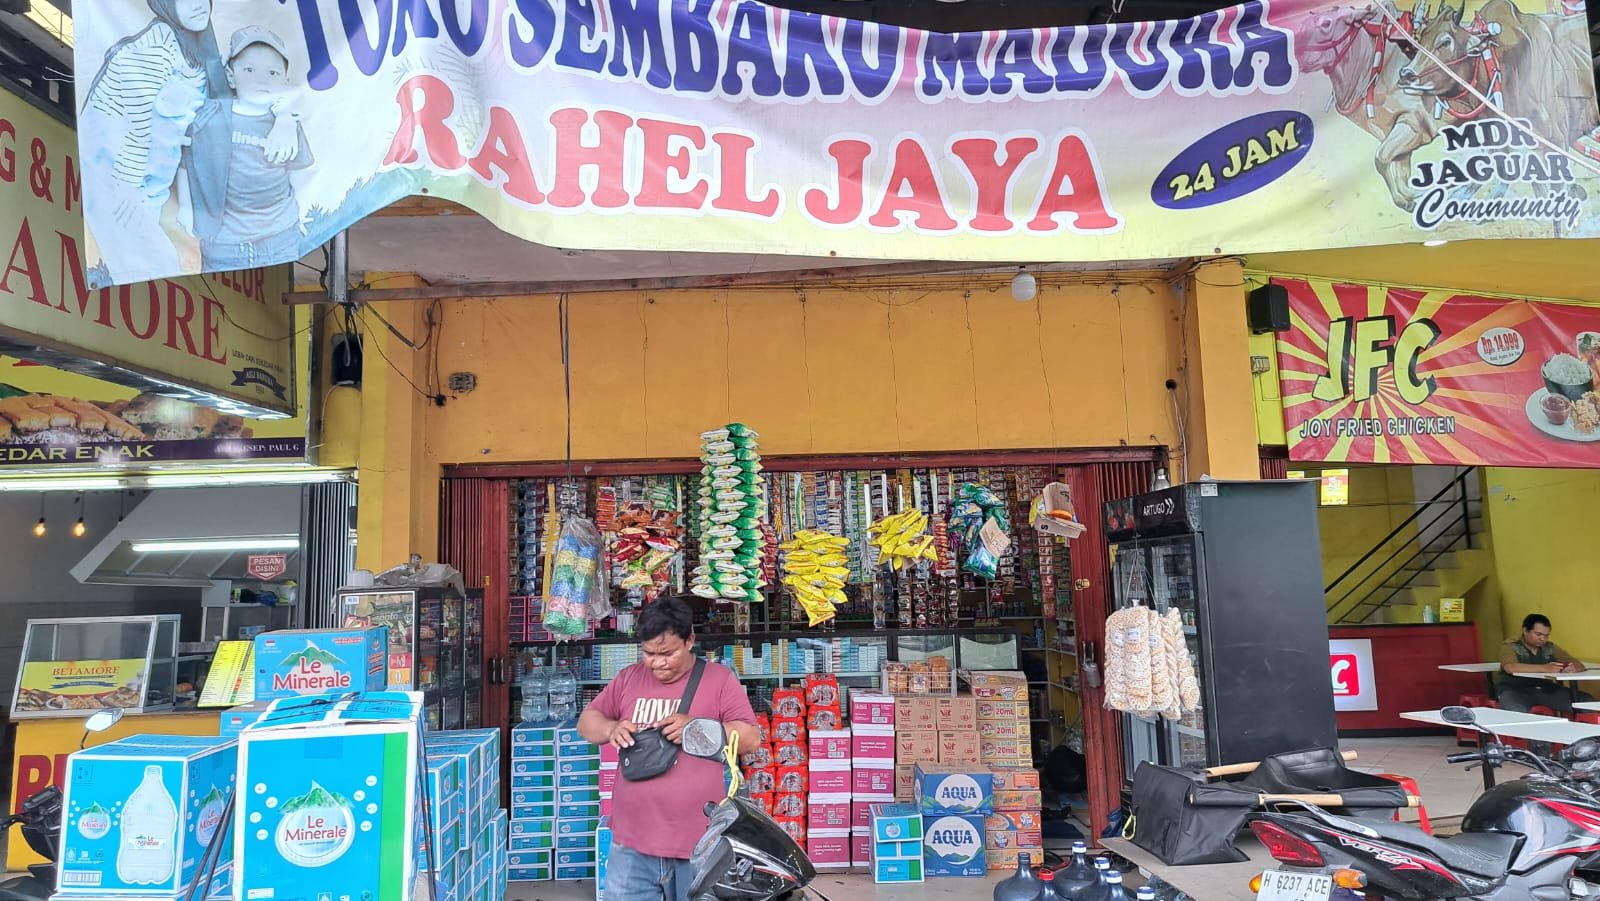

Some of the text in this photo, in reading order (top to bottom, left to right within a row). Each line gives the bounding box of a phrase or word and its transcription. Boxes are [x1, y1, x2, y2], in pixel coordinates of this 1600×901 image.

[383, 75, 1118, 230] RAHEL JAYA
[1169, 121, 1299, 200] 24 JAM
[30, 137, 54, 204] &
[1411, 154, 1574, 188] JAGUAR
[1416, 188, 1581, 228] Community
[1312, 315, 1442, 405] JFC
[1300, 416, 1456, 438] JOY FRIED CHICKEN
[75, 445, 155, 459] ENAK
[1143, 502, 1165, 516] ARTUGO
[255, 565, 279, 573] DISINI
[53, 666, 121, 676] BETAMORE
[300, 656, 322, 675] Le
[273, 671, 350, 690] Minerale
[996, 727, 1016, 735] 20mL
[997, 746, 1017, 754] 20mL
[941, 786, 977, 801] AQUA
[307, 815, 324, 829] Le
[285, 825, 347, 842] Minerale
[932, 829, 974, 847] AQUA
[1263, 872, 1329, 895] H 6237 ACE
